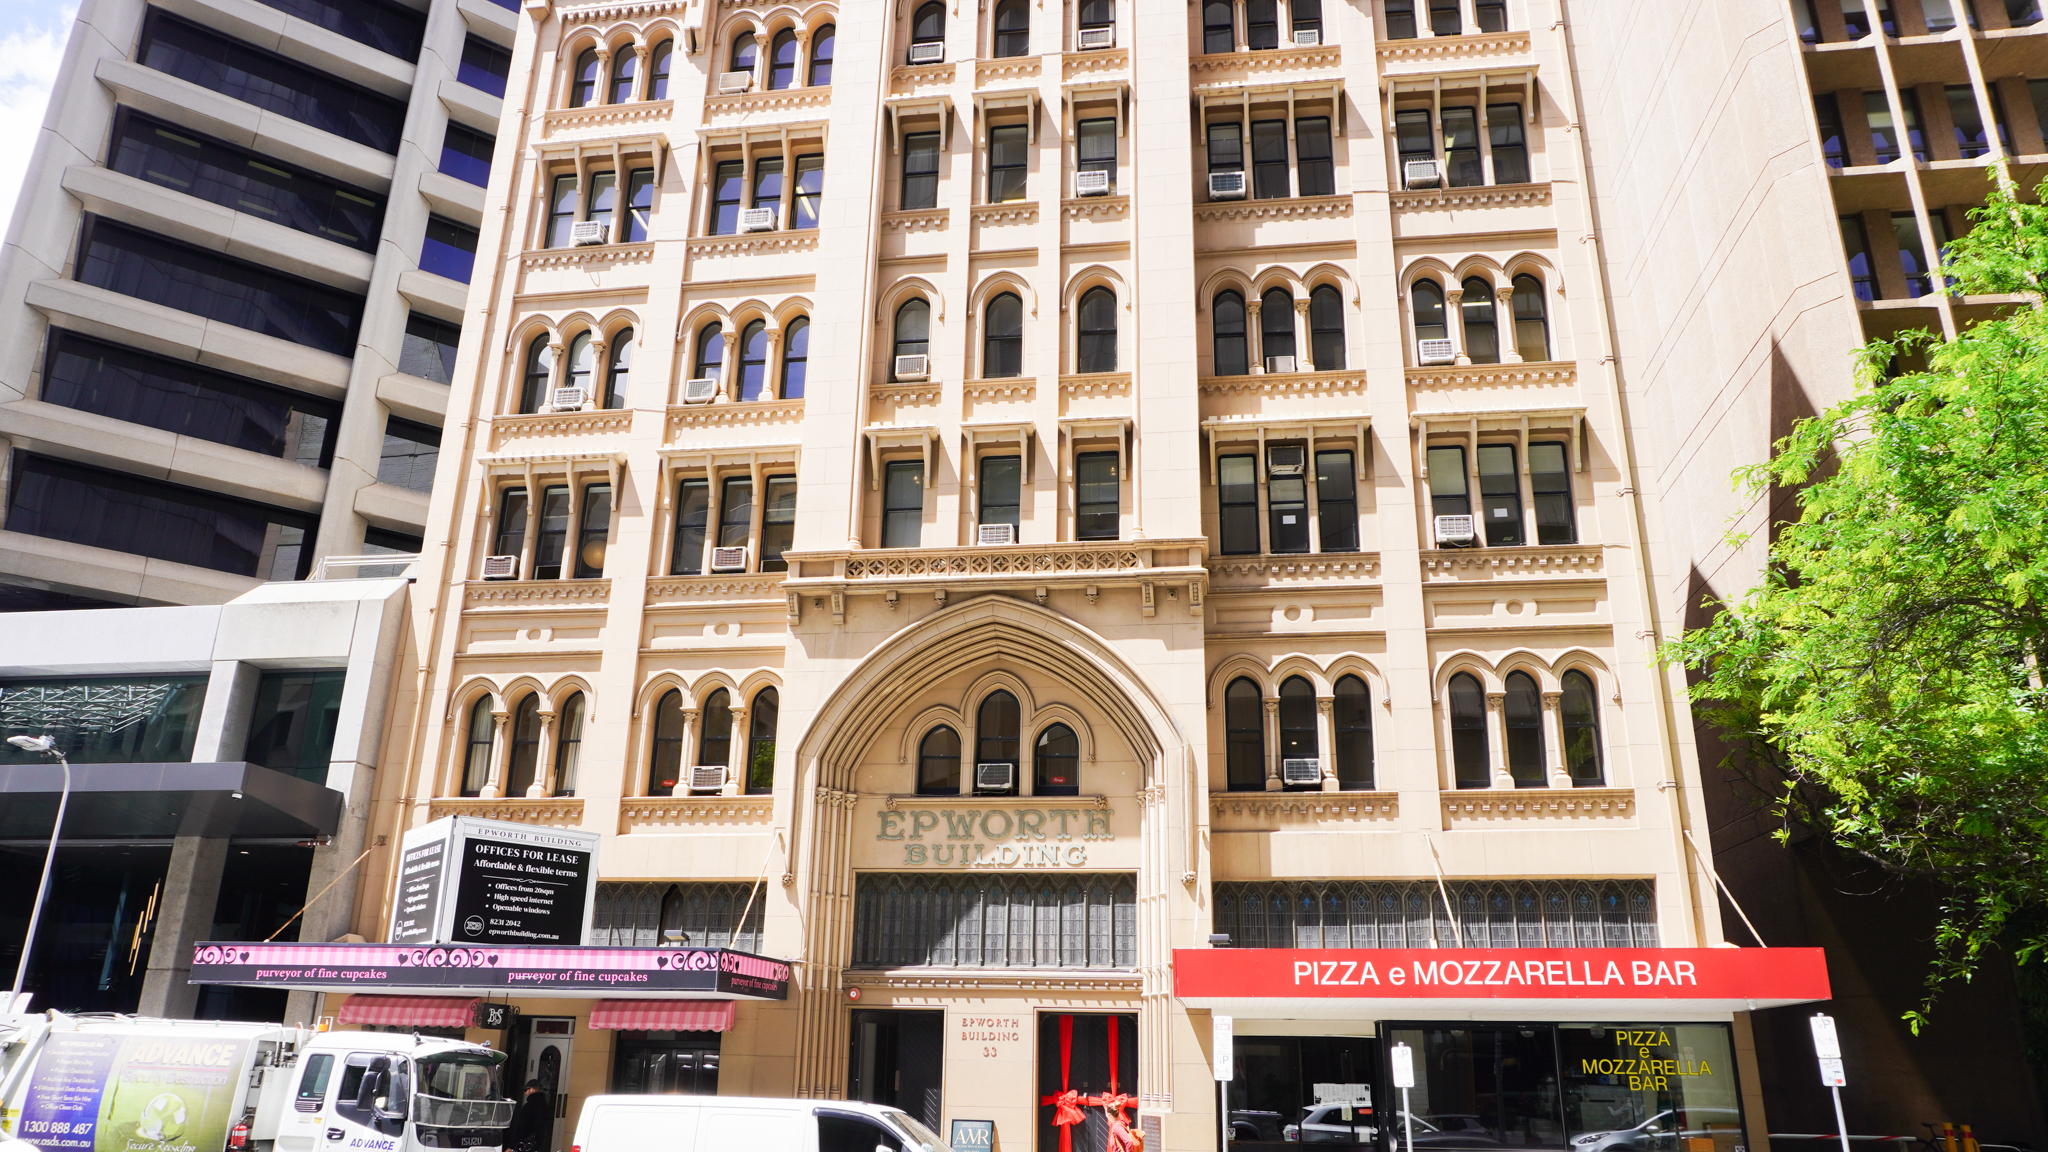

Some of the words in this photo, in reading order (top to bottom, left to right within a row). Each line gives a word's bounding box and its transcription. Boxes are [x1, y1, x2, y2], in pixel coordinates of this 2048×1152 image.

[876, 809, 1115, 841] EPWORTH
[478, 828, 527, 840] EPWORTH
[534, 835, 582, 847] BUILDING
[475, 844, 520, 858] OFFICES
[522, 849, 544, 861] FOR
[546, 852, 579, 865] LEASE
[903, 844, 1088, 867] BUILDING
[473, 859, 519, 872] Affordable
[517, 863, 524, 872] &
[525, 864, 555, 876] flexible
[555, 868, 578, 878] terms
[495, 883, 517, 892] Offices
[518, 885, 534, 893] from
[534, 887, 554, 896] 20sqm
[493, 893, 509, 902] High
[509, 895, 528, 903] speed
[529, 897, 554, 906] internet
[492, 903, 522, 913] Openable
[523, 905, 551, 915] windows
[489, 918, 504, 926] 8231
[505, 919, 521, 928] 2042
[488, 928, 560, 940] epworthbuilding.com.au
[255, 969, 303, 981] purveyor
[304, 967, 317, 979] of
[317, 968, 338, 979] fine
[340, 969, 388, 982] cupcakes
[507, 971, 557, 984] purveyor
[559, 970, 573, 981] of
[573, 970, 597, 982] fine
[598, 971, 649, 985] cupcakes
[1292, 960, 1381, 986] PIZZA
[1388, 967, 1406, 986] e
[1413, 960, 1626, 987] MOZZARELLA
[1631, 960, 1698, 987] BAR
[961, 1017, 1020, 1028] EPWORTH
[961, 1031, 1020, 1042] BUILDING
[1615, 1030, 1671, 1047] PIZZA
[128, 1041, 238, 1067] ADVANCE
[982, 1046, 998, 1058] 33
[1638, 1046, 1650, 1059] e
[1222, 1055, 1230, 1065] P
[1582, 1058, 1713, 1076] MOZZARELLA
[123, 1070, 166, 1086] Security
[165, 1072, 228, 1086] Destruction
[1628, 1075, 1669, 1092] BAR
[23, 1120, 49, 1134] 1300
[50, 1121, 71, 1135] 888
[72, 1122, 94, 1136] 487
[124, 1138, 155, 1152] Secure
[350, 1138, 396, 1151] ADVANCE
[461, 1137, 483, 1147] ISUZU
